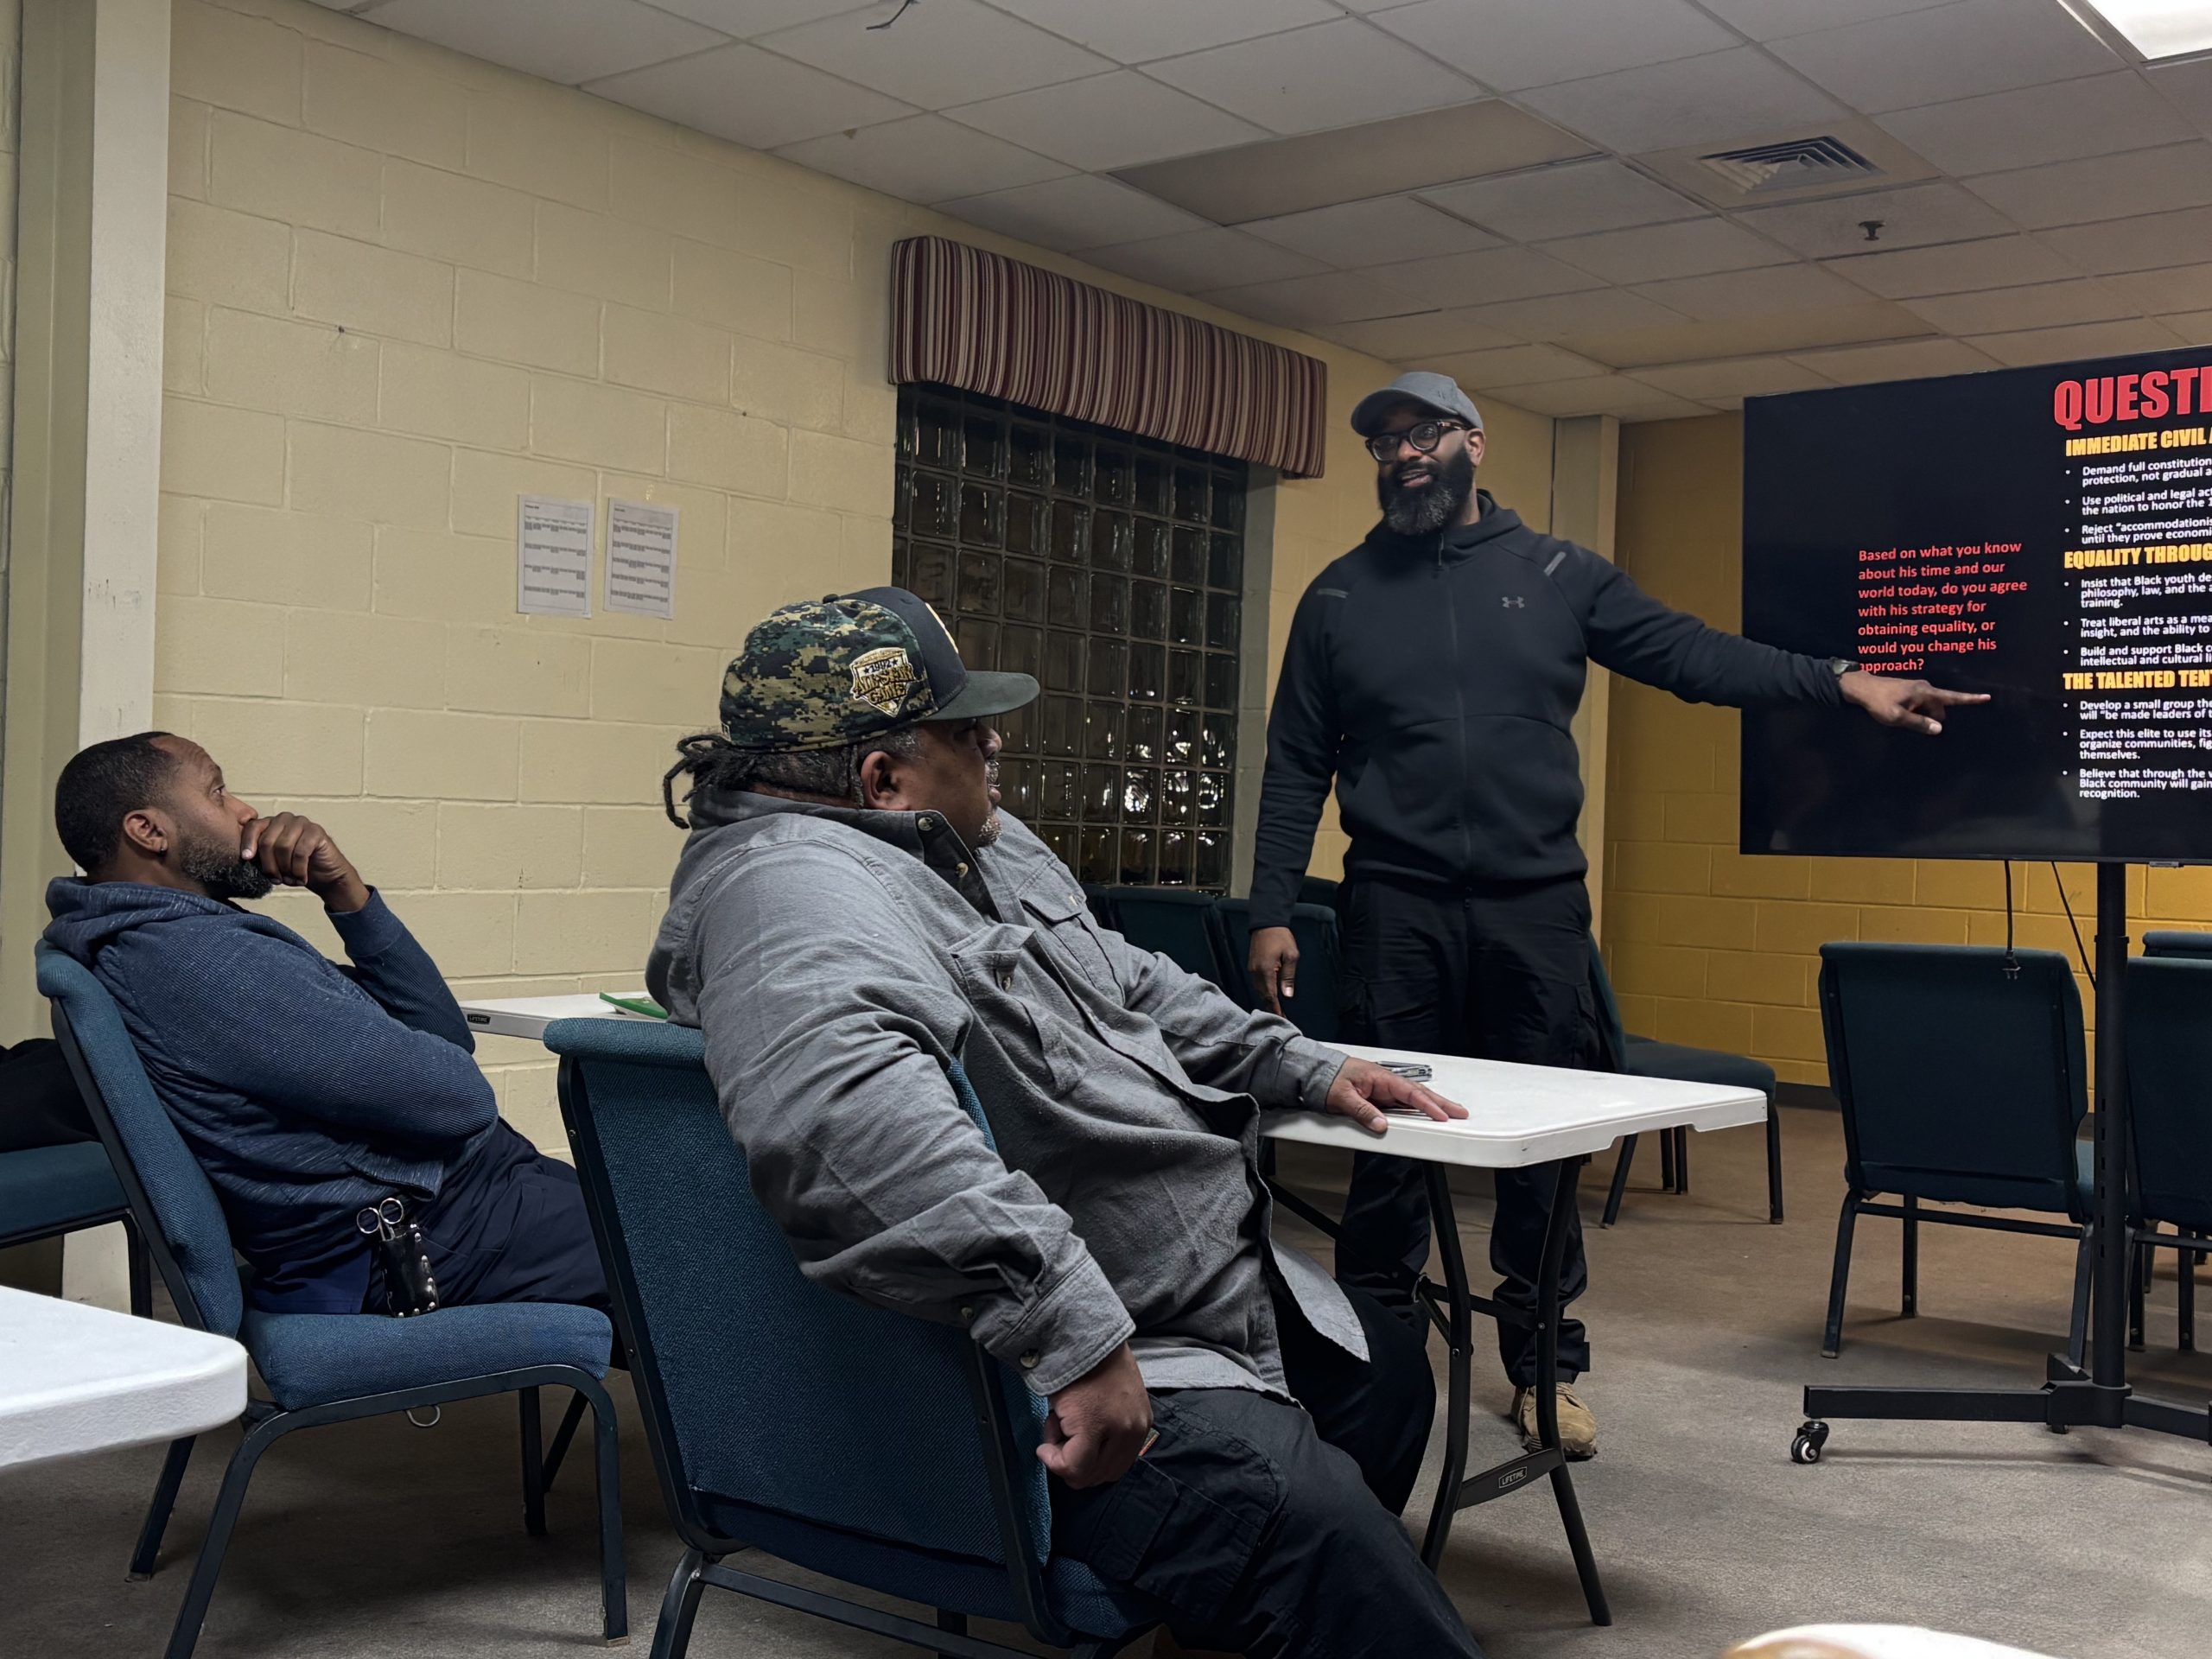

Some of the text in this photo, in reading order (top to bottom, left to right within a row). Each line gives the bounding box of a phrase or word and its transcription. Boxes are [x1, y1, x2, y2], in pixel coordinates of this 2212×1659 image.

[2065, 432, 2158, 457] IMMEDIATE
[2160, 427, 2207, 448] CIVIL
[2082, 463, 2126, 475] Demand
[2127, 461, 2146, 472] full
[2082, 473, 2139, 487] protection,
[2141, 470, 2160, 480] not
[2162, 467, 2203, 481] gradual
[2082, 495, 2102, 505] Use
[2103, 492, 2145, 505] political
[2146, 490, 2168, 500] and
[2170, 488, 2196, 500] legal
[2082, 505, 2100, 514] the
[2101, 502, 2135, 513] nation
[2137, 501, 2150, 511] to
[2151, 500, 2185, 510] honor
[2185, 498, 2205, 508] the
[2082, 522, 2113, 535] Reject
[2081, 532, 2106, 543] until
[2107, 531, 2132, 543] they
[2133, 531, 2164, 543] prove
[1859, 543, 2022, 561] Based on what you know
[2064, 543, 2212, 569] EQUALITY THROUG
[1858, 563, 2005, 580] about his time and our
[2081, 577, 2108, 588] Insist
[2109, 576, 2132, 587] that
[2133, 575, 2162, 586] Black
[2164, 574, 2196, 587] youth
[1858, 582, 2028, 598] world today, do you agree
[2081, 587, 2139, 601] philosophy,
[2141, 586, 2163, 597] law,
[2164, 584, 2186, 594] and
[2187, 583, 2207, 594] the
[1858, 601, 1986, 617] with his strategy for
[2080, 596, 2124, 608] training.
[1858, 620, 1996, 636] obtaining equality, or
[2081, 617, 2107, 627] Treat
[2108, 615, 2142, 626] liberal
[2143, 615, 2164, 625] arts
[2080, 624, 2210, 639] insight, and the ability to
[1858, 639, 1997, 656] would you change his
[2080, 645, 2107, 656] Build
[2108, 645, 2129, 655] and
[2130, 644, 2172, 657] support
[2174, 643, 2203, 653] Black
[2080, 655, 2138, 665] intellectual
[2139, 654, 2160, 664] and
[2161, 653, 2203, 664] cultural
[2063, 669, 2212, 690] THE TALENTED TEN
[2080, 700, 2122, 712] Develop
[2133, 699, 2161, 709] small
[2162, 701, 2195, 711] group
[2079, 710, 2098, 720] will
[2120, 709, 2151, 719] made
[2152, 709, 2192, 719] leaders
[2193, 709, 2206, 718] of
[2080, 728, 2114, 741] Expect
[2115, 728, 2136, 738] this
[2137, 728, 2161, 738] elite
[2163, 728, 2176, 738] to
[2198, 728, 2212, 738] its
[2079, 739, 2123, 751] organize
[2124, 738, 2196, 750] communities,
[2079, 749, 2141, 760] themselves.
[2079, 768, 2117, 778] Believe
[2118, 768, 2140, 778] that
[2142, 768, 2185, 780] through
[2187, 768, 2206, 779] the
[2079, 779, 2212, 791] Black community will gain
[2079, 788, 2140, 800] recognition.
